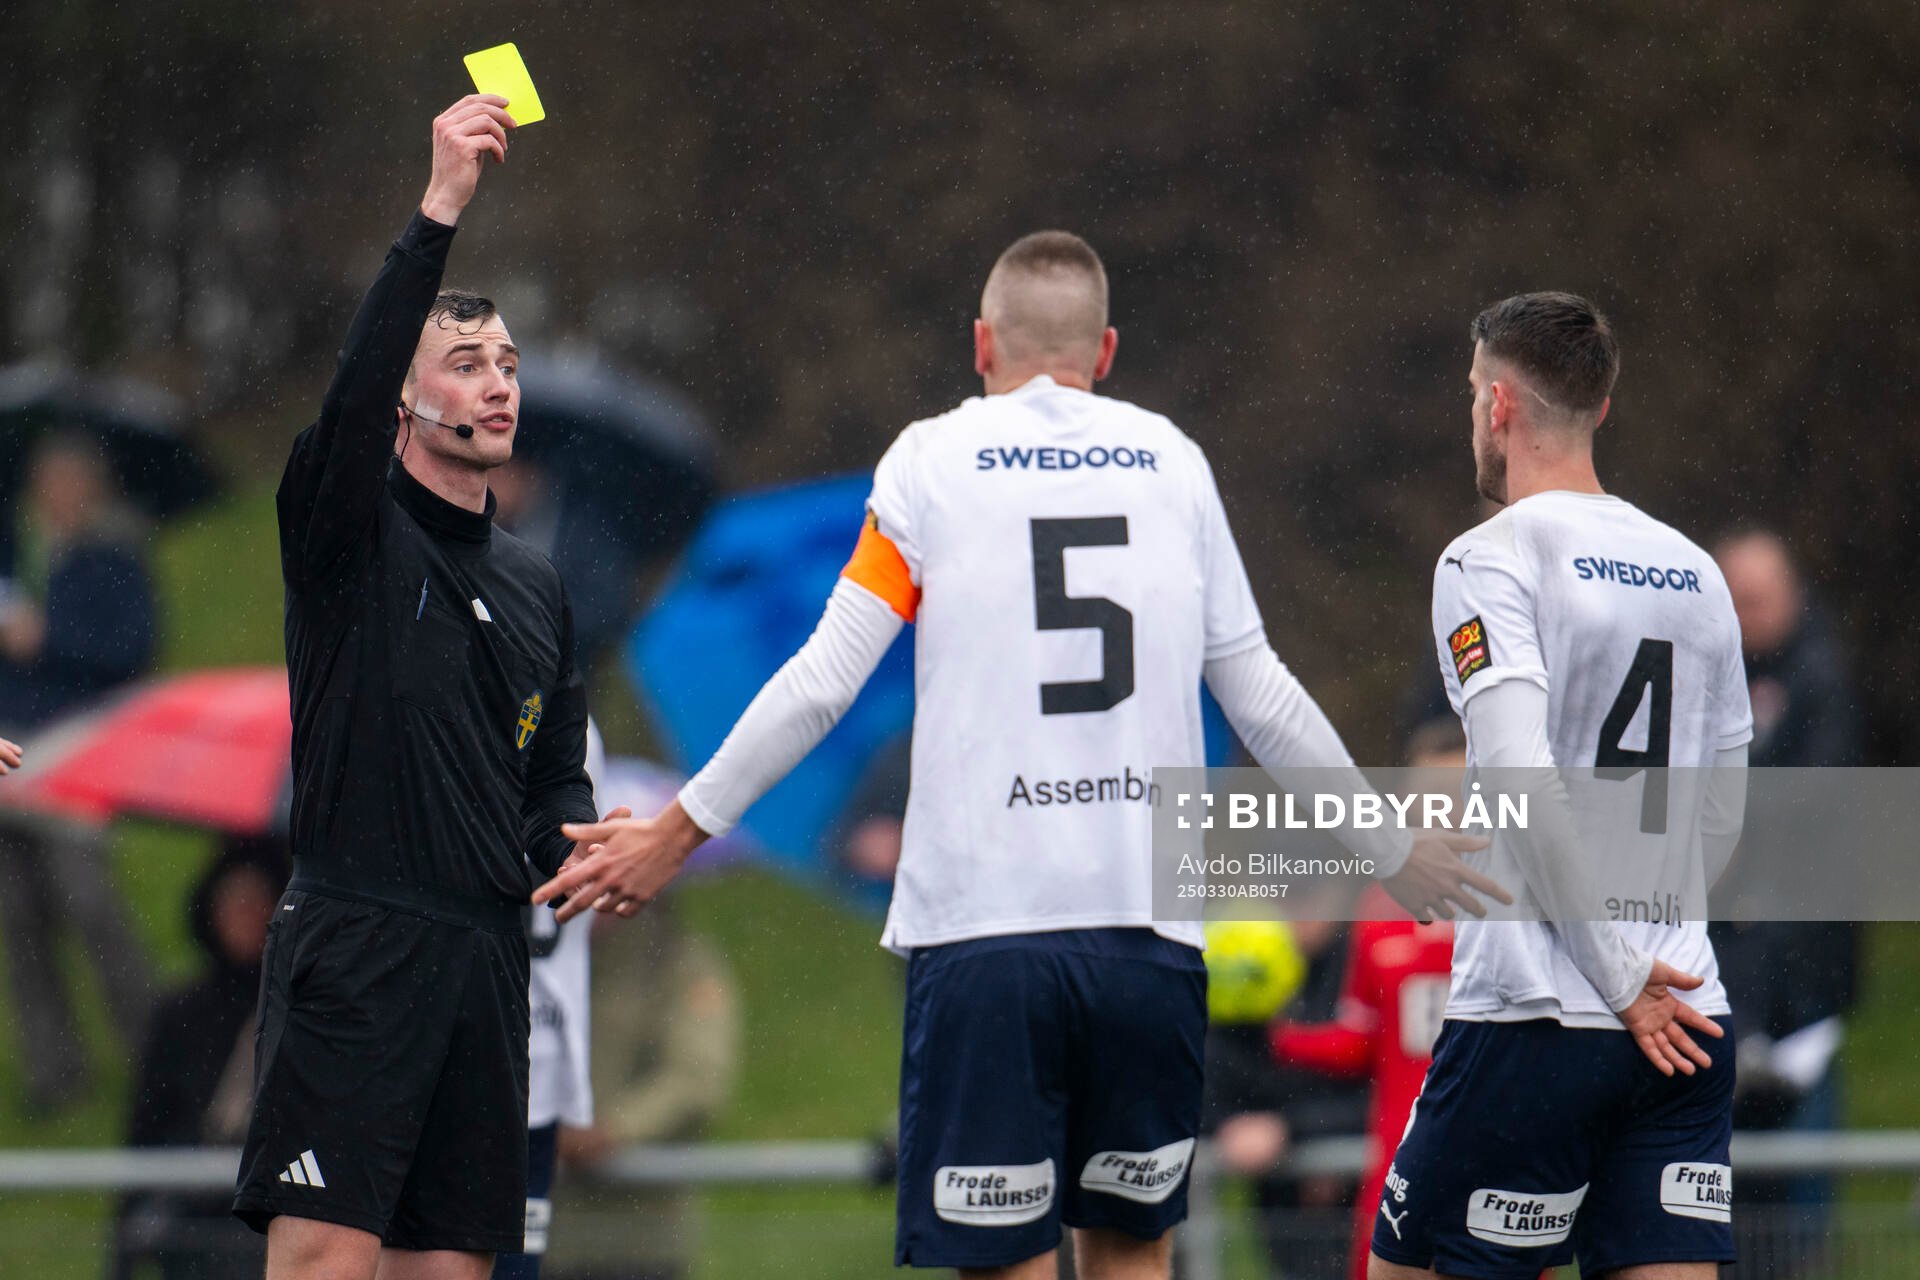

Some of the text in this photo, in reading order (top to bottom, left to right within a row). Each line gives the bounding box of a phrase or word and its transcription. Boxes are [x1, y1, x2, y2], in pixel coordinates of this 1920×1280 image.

[976, 446, 1158, 473] SWEDOOR
[1573, 557, 1702, 594] SWEDOOR
[1029, 515, 1135, 716] 5
[1593, 637, 1674, 835] 4
[1101, 1154, 1158, 1172] Frode
[946, 1171, 1007, 1190] Frode
[1675, 1166, 1722, 1187] Frode
[1483, 1193, 1545, 1216] Frode
[1695, 1186, 1732, 1206] LAURS
[1503, 1209, 1576, 1231] LAURSE
